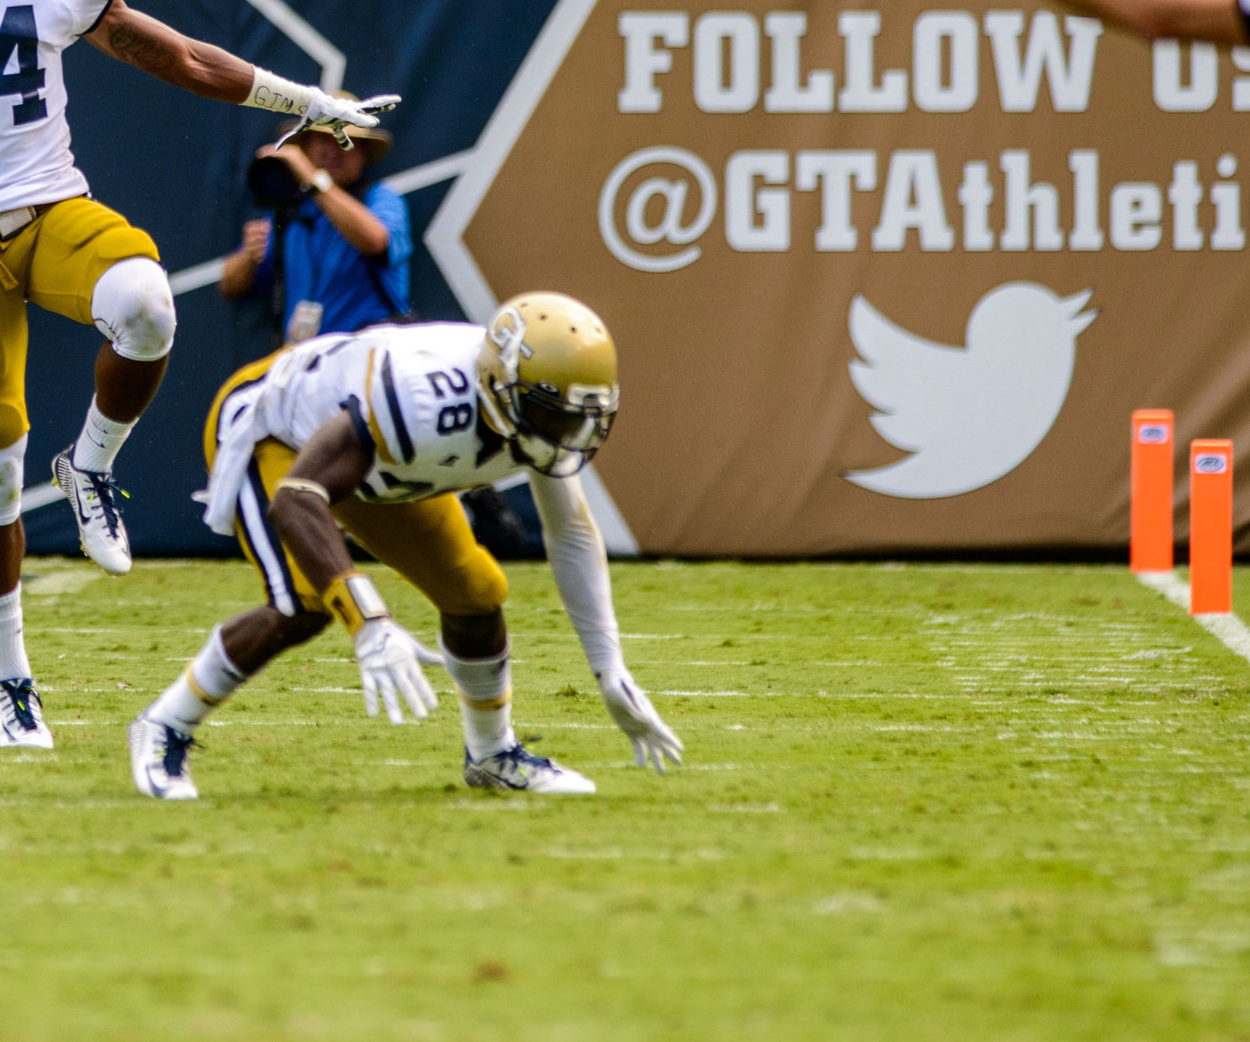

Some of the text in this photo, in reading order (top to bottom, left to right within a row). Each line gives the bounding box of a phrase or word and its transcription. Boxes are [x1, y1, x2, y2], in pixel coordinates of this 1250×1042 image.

[617, 10, 1104, 113] FOLLOW
[598, 145, 1246, 273] @GTAthleti
[425, 367, 473, 436] 28
